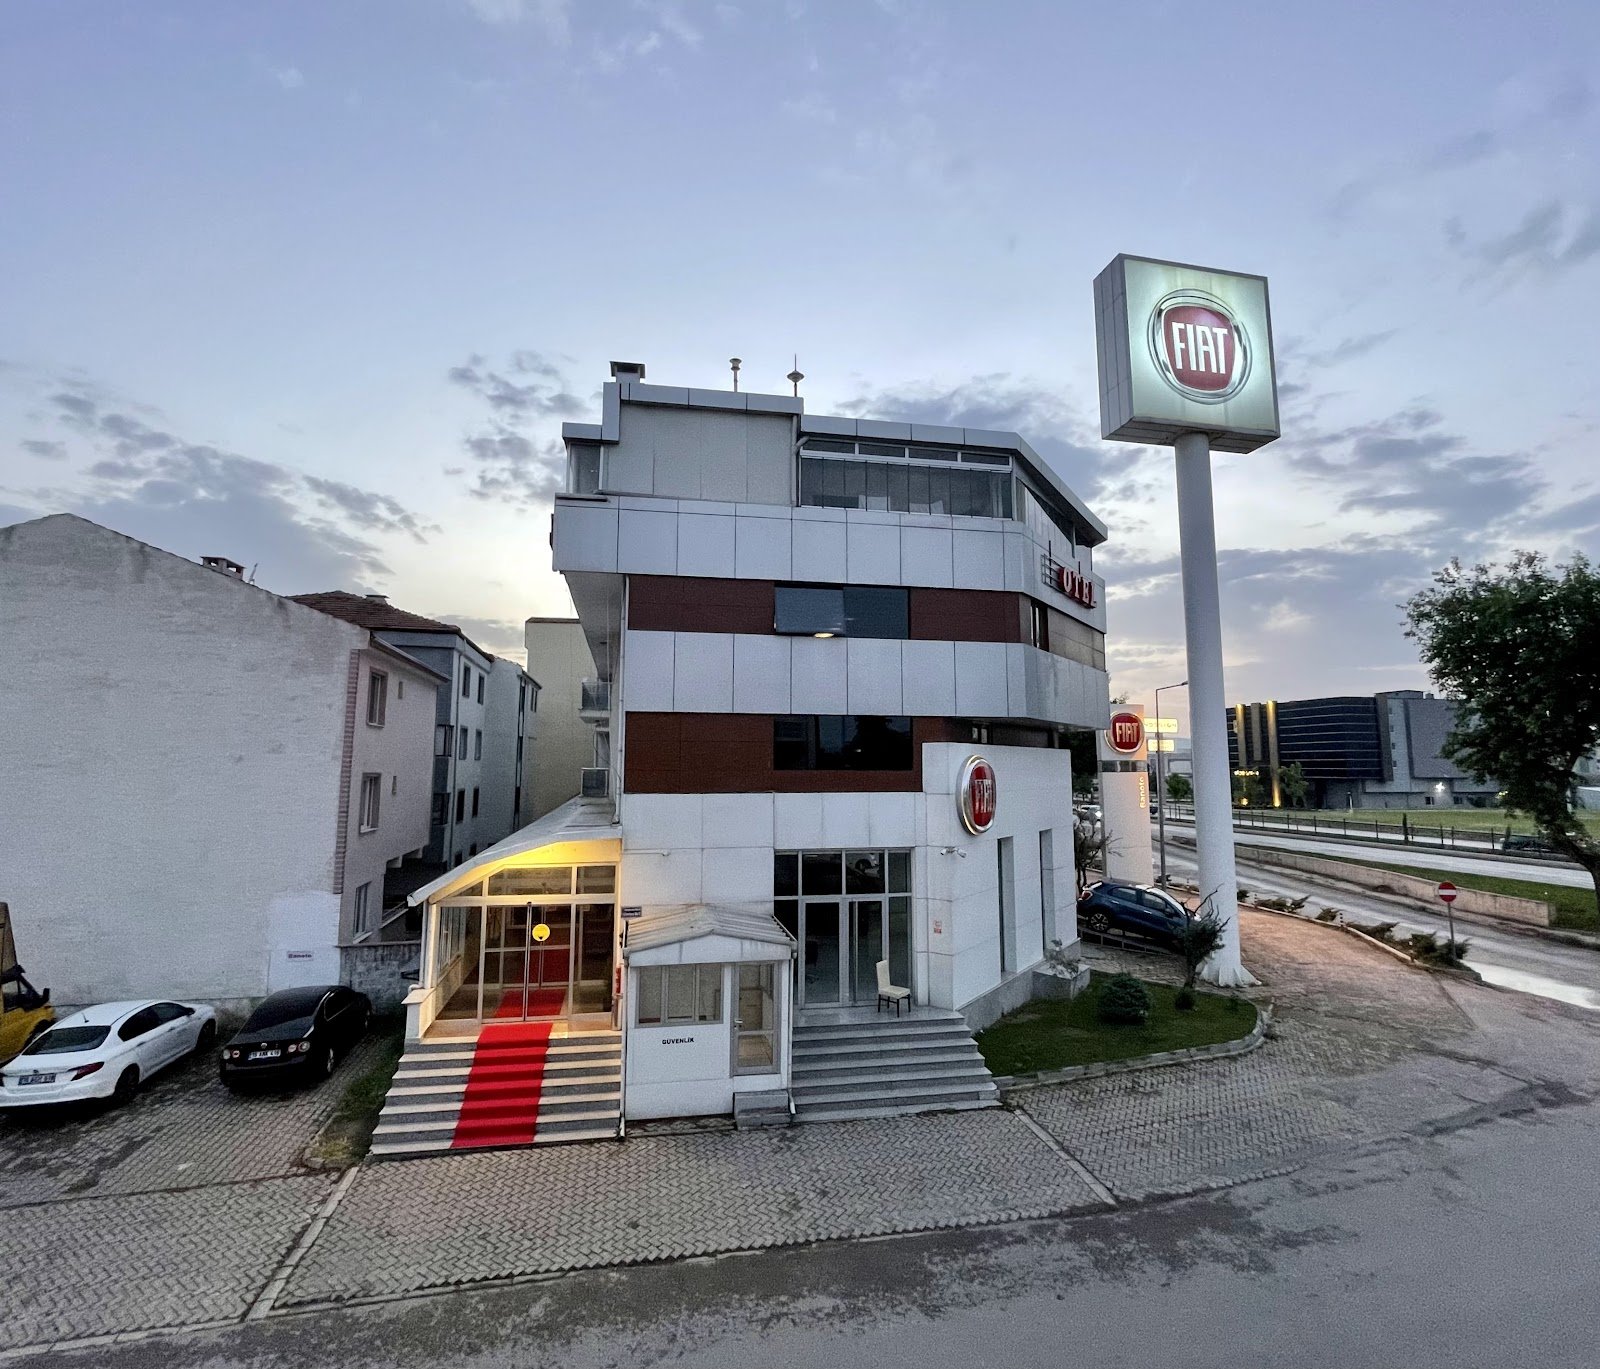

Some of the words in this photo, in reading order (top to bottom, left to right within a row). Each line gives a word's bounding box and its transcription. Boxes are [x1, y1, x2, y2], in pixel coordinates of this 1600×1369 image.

[1171, 321, 1228, 374] FIAT
[1063, 567, 1097, 606] OTEL
[1115, 722, 1139, 743] FIAT
[974, 778, 993, 813] FIAT
